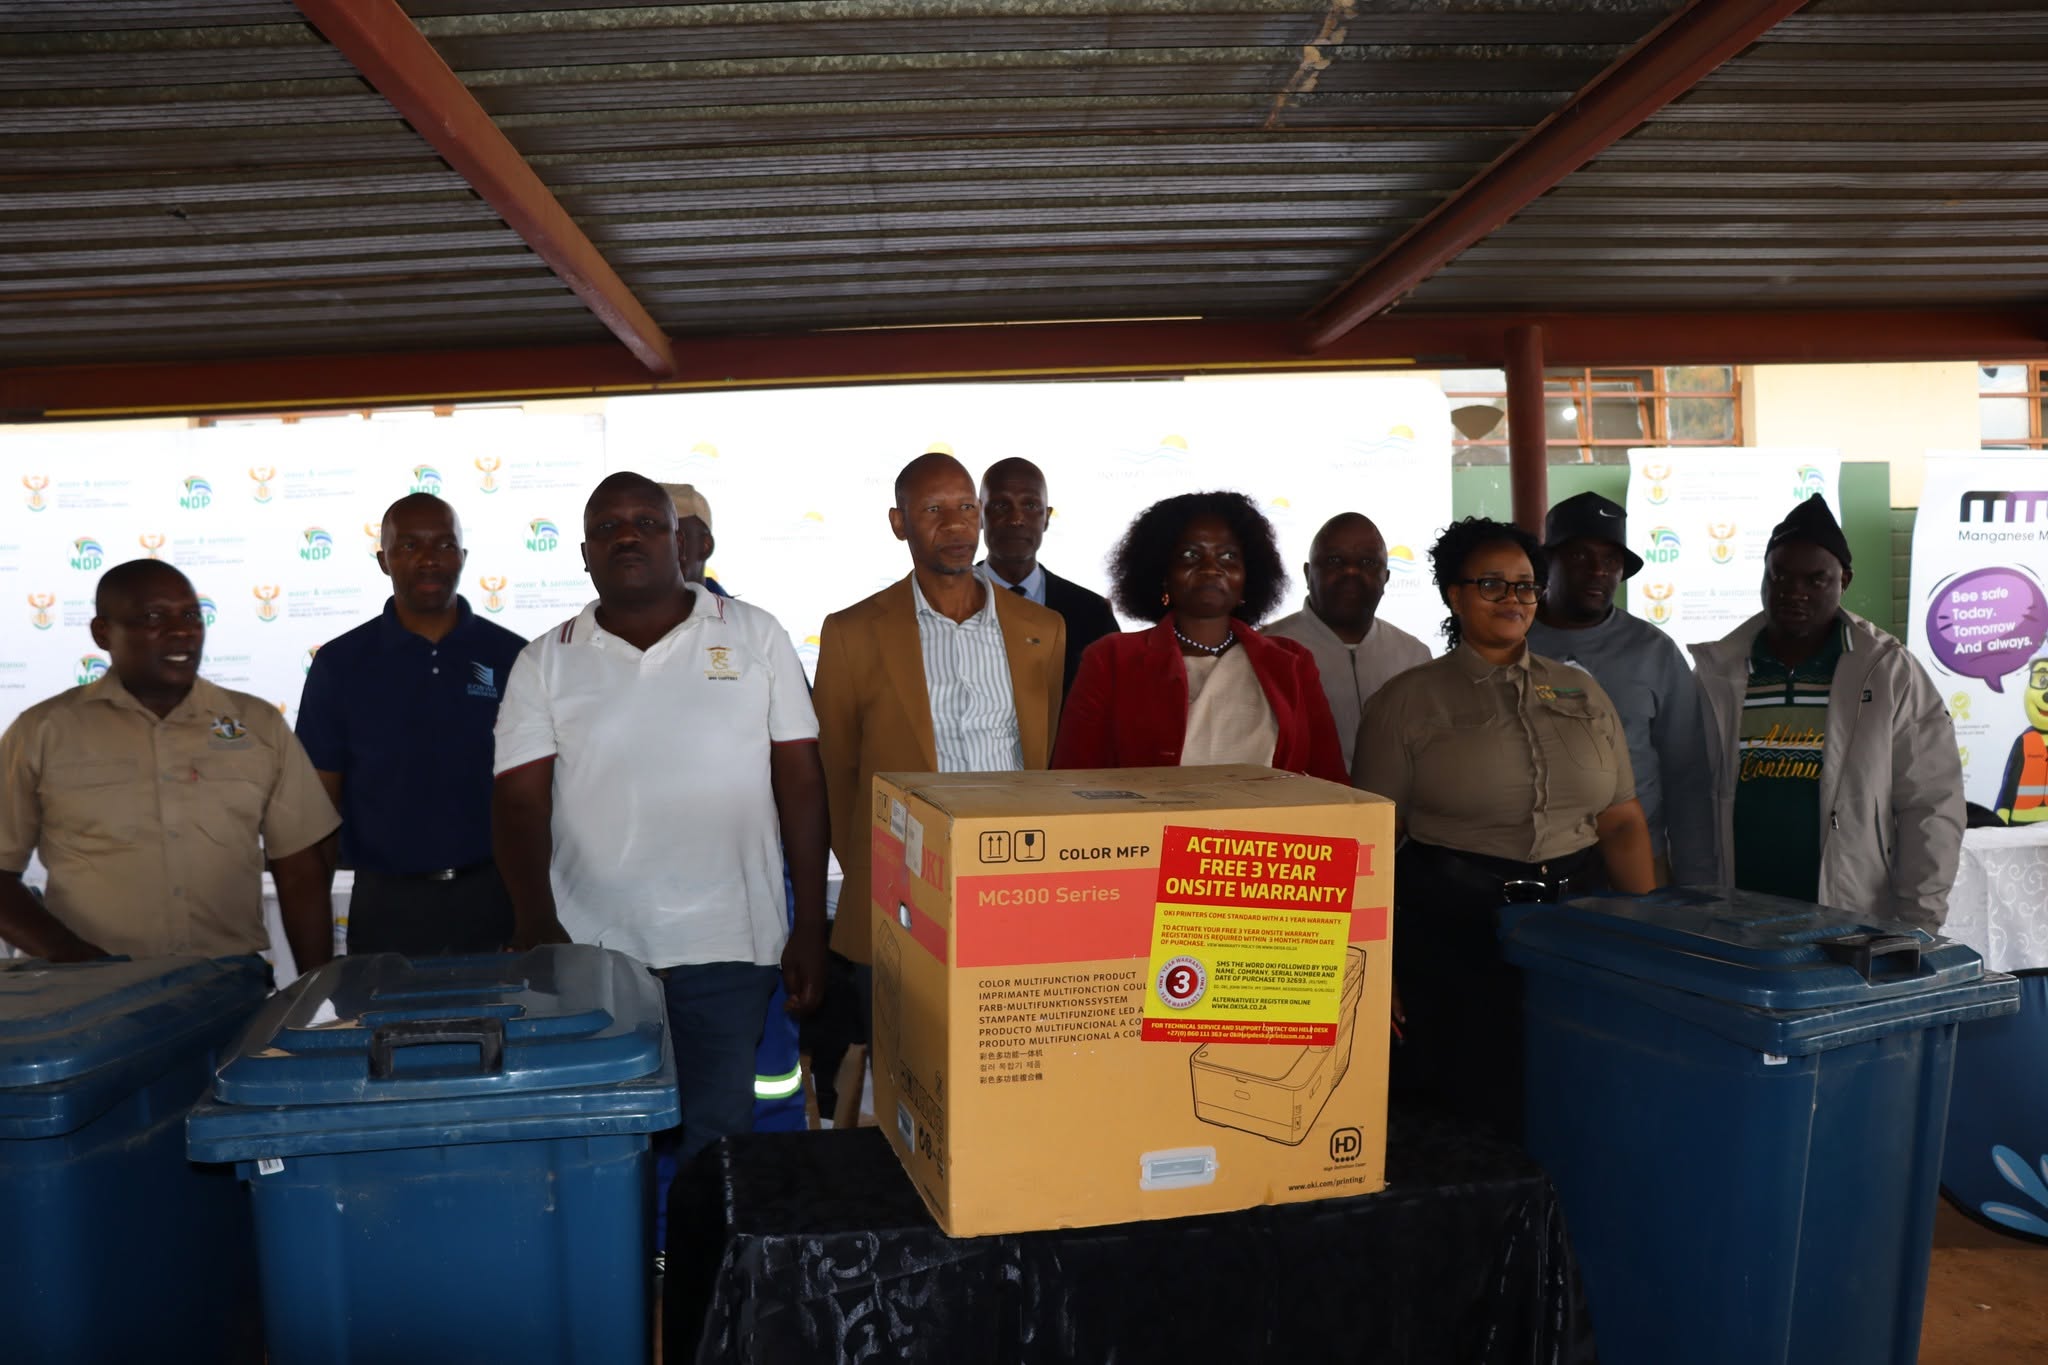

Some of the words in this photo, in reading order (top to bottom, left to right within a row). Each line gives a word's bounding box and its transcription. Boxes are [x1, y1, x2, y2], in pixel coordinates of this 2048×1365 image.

[180, 496, 210, 509] NDP
[1959, 530, 2034, 543] Manganese
[526, 539, 557, 552] NDP
[300, 547, 331, 561] NDP
[1645, 549, 1680, 563] NDP
[70, 557, 101, 571] NDP
[1952, 591, 1978, 603] Bee
[1982, 587, 2008, 600] safe
[1953, 607, 1996, 620] Today.
[1953, 621, 2015, 637] Tomorrow
[1954, 640, 1982, 654] And
[1988, 636, 2032, 652] always.
[1741, 752, 1823, 781] Continu
[1060, 848, 1111, 860] COLOR
[1117, 845, 1150, 858] MFP
[1186, 837, 1278, 858] ACTIVATE
[1283, 842, 1332, 861] YOUR
[1200, 859, 1247, 877] FREE
[1251, 862, 1262, 878] 3
[1267, 862, 1316, 881] YEAR
[979, 888, 1049, 907] MC300
[1056, 886, 1120, 903] Series
[1166, 878, 1236, 898] ONSITE
[1240, 882, 1347, 903] WARRANTY
[979, 979, 1011, 988] COLOR
[1014, 974, 1090, 987] MULTIFUNCTION
[1093, 971, 1136, 981] PRODUCT
[1173, 970, 1190, 994] 3
[979, 990, 1040, 1000] IMPRIMANTE
[1044, 985, 1120, 997] MULTIFONCTION
[1123, 982, 1147, 991] COUL
[979, 996, 1128, 1012] FARB-MULTIFUNKTIONSSYSTEM
[979, 1014, 1036, 1024] STAMPANTE
[1039, 1009, 1116, 1021] MULTIFUNZIONE
[1119, 1007, 1135, 1015] LED
[1138, 1006, 1144, 1014] A
[979, 1026, 1032, 1036] PRODUCTO
[1035, 1020, 1117, 1033] MULTIFUNCIONAL
[979, 1038, 1025, 1048] PRODUTO
[1029, 1032, 1111, 1045] MULTIFUNCIONAL
[1113, 1031, 1120, 1039] A
[1335, 1136, 1356, 1153] HD
[1288, 1175, 1366, 1191] www.oki.com/printing/
